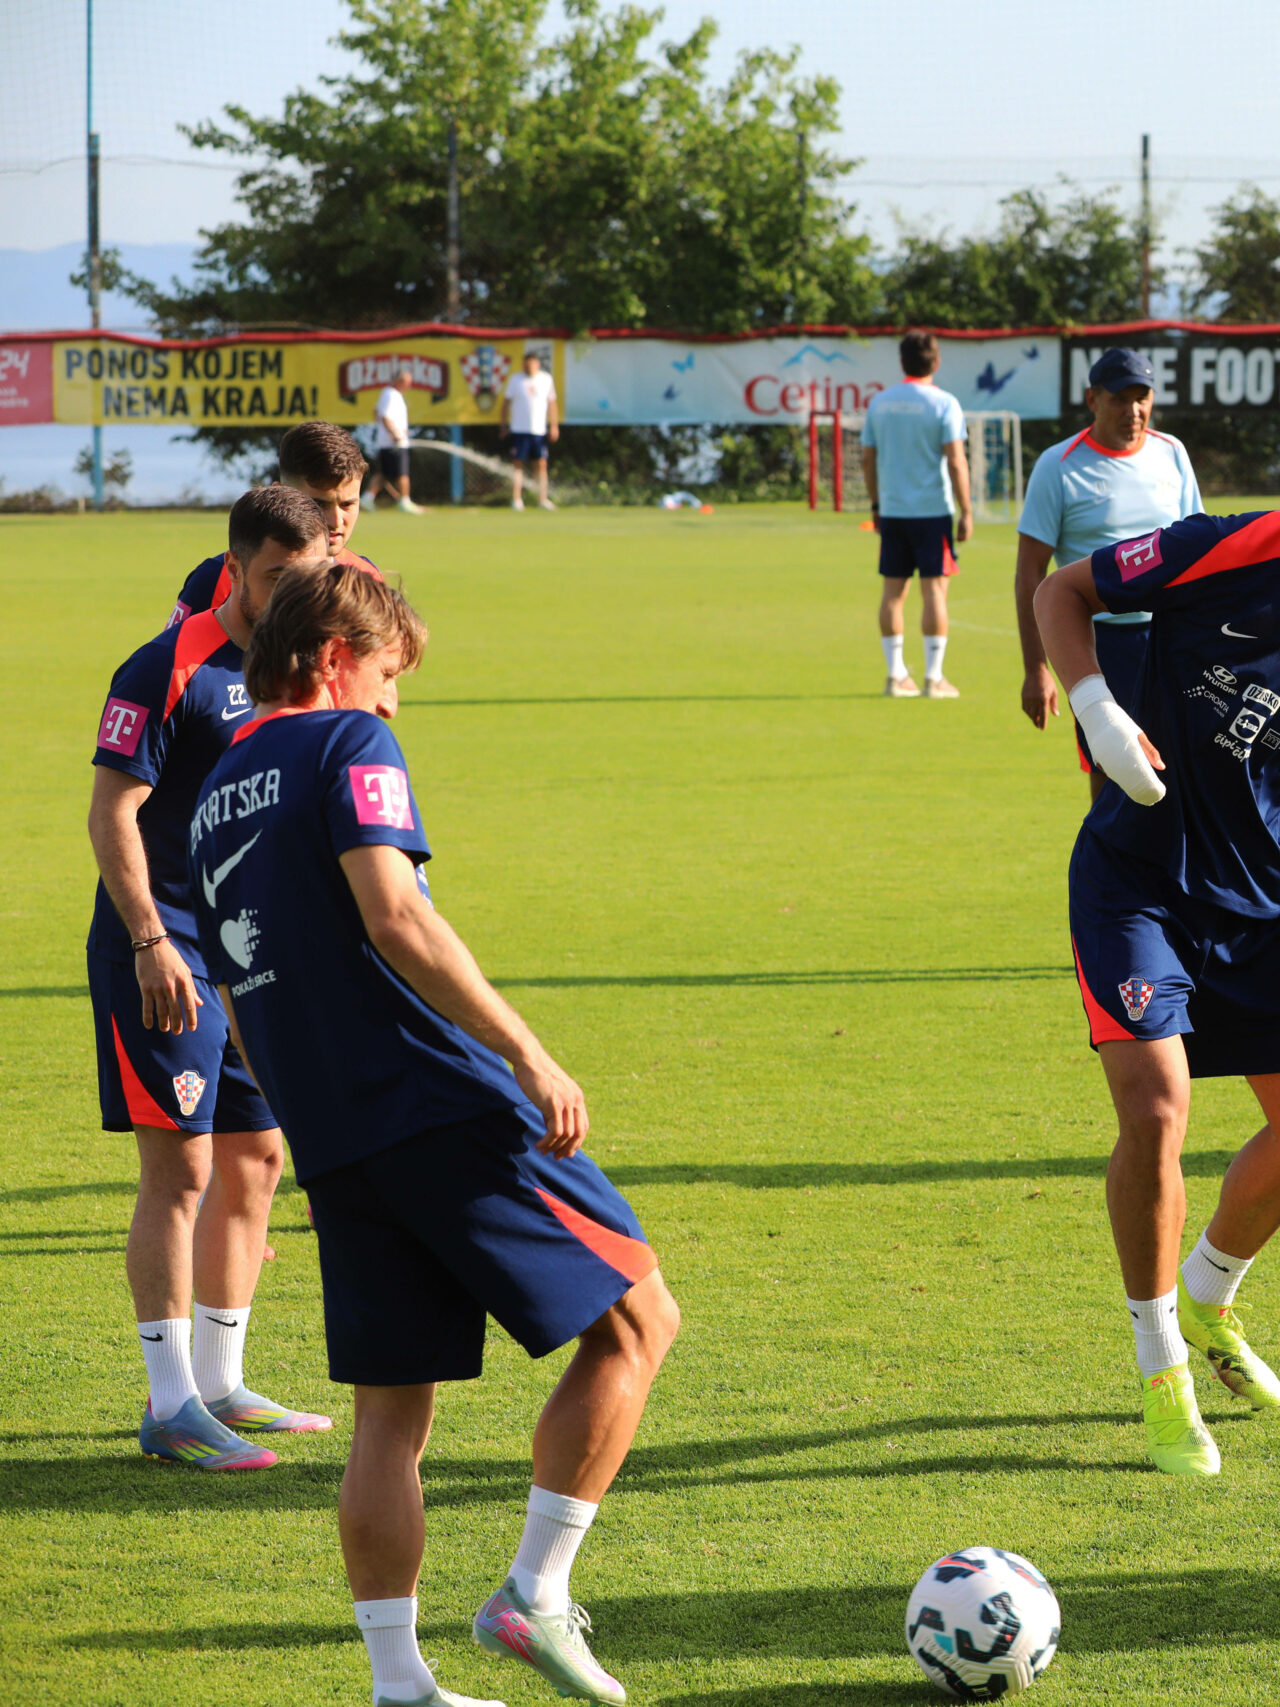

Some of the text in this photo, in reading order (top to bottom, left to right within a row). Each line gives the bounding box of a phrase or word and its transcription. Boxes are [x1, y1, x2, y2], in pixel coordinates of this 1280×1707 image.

[65, 348, 284, 380] PONOS KOJEM
[103, 386, 320, 417] NEMA KRAJA!
[744, 373, 884, 416] Cetina
[227, 684, 248, 706] 22
[1202, 669, 1238, 697] HYUNDAI
[1203, 690, 1230, 714] CROATIA
